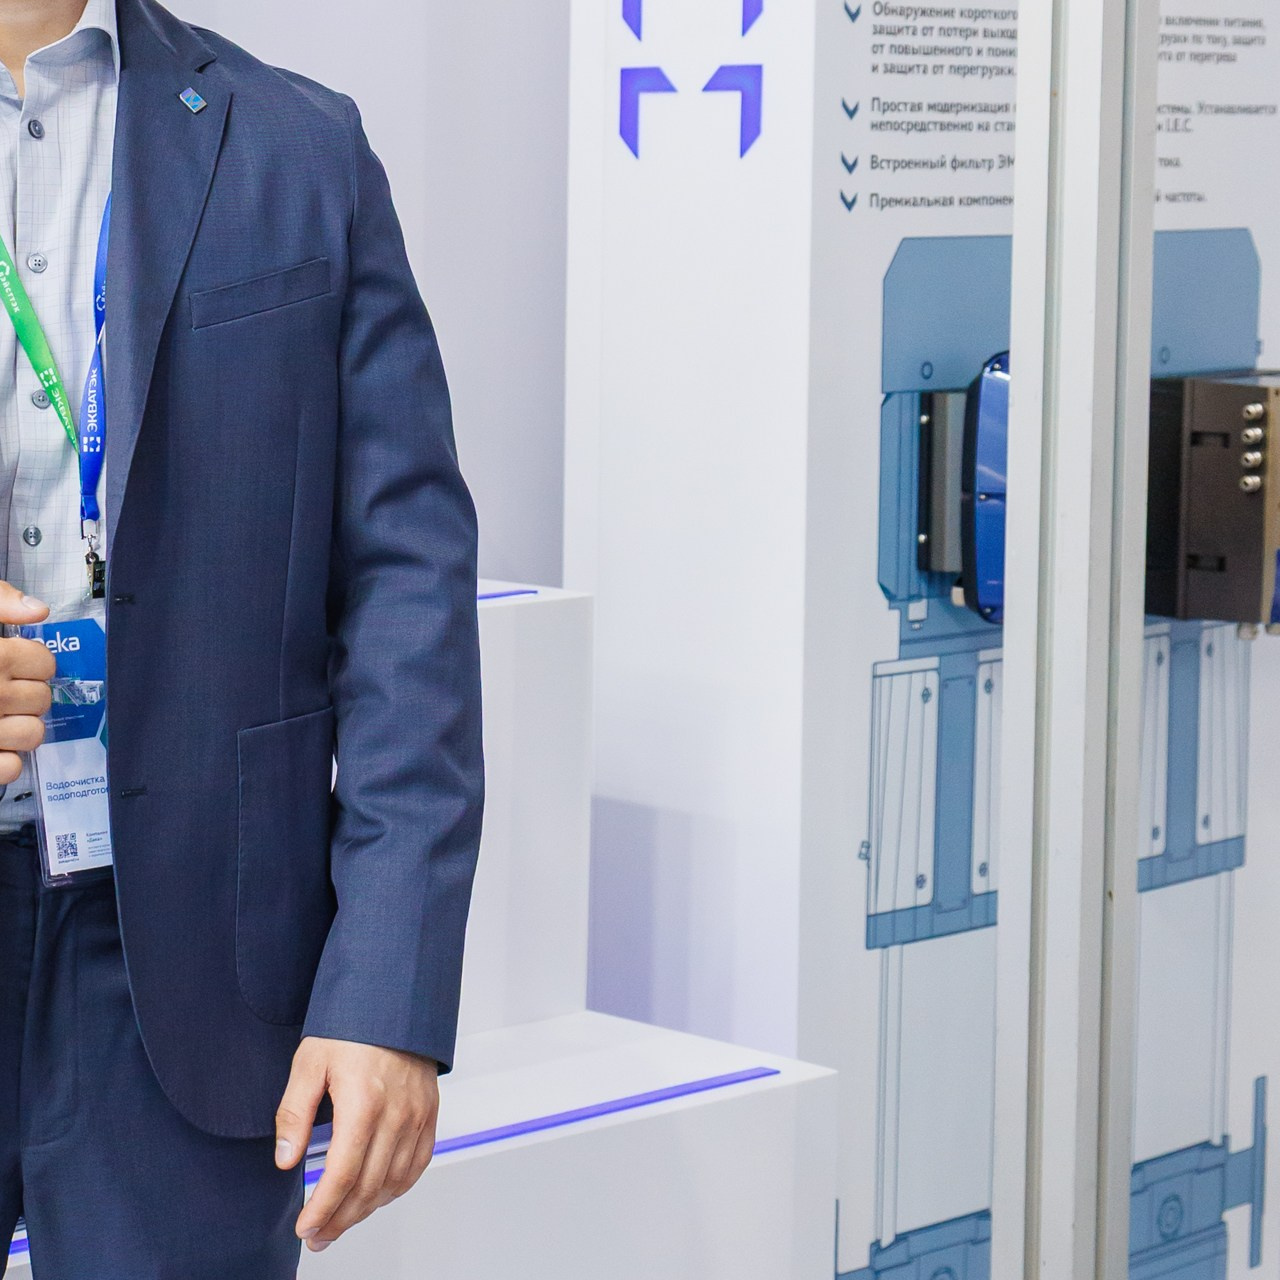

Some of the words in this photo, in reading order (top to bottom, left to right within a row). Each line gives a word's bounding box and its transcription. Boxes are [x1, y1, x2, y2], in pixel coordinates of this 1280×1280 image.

[872, 0, 956, 21] Обнаружение
[959, 7, 1018, 22] короткого
[872, 23, 918, 37] защита
[921, 25, 934, 37] от
[938, 25, 979, 40] потери
[982, 27, 1018, 40] выход
[871, 43, 885, 55] от
[889, 43, 973, 57] повышенного
[976, 46, 984, 58] и
[986, 46, 1017, 58] пони
[871, 63, 879, 74] и
[882, 62, 929, 76] защита
[932, 64, 945, 76] от
[948, 65, 1017, 80] перегрузки.
[871, 96, 924, 116] Простая
[927, 101, 1011, 115] модернизация
[870, 119, 974, 135] непосредственно
[977, 121, 991, 132] на
[994, 120, 1016, 133] ста
[870, 154, 947, 173] Встроенный
[950, 154, 995, 172] фильтр
[997, 153, 1016, 169] ЭМ
[869, 192, 955, 211] Премиальная
[958, 195, 1015, 208] компонен
[86, 367, 98, 433] ЭКВАТЭК
[32, 631, 81, 654] eka
[45, 775, 106, 791] Водоочистка
[47, 786, 108, 802] водоподгото
